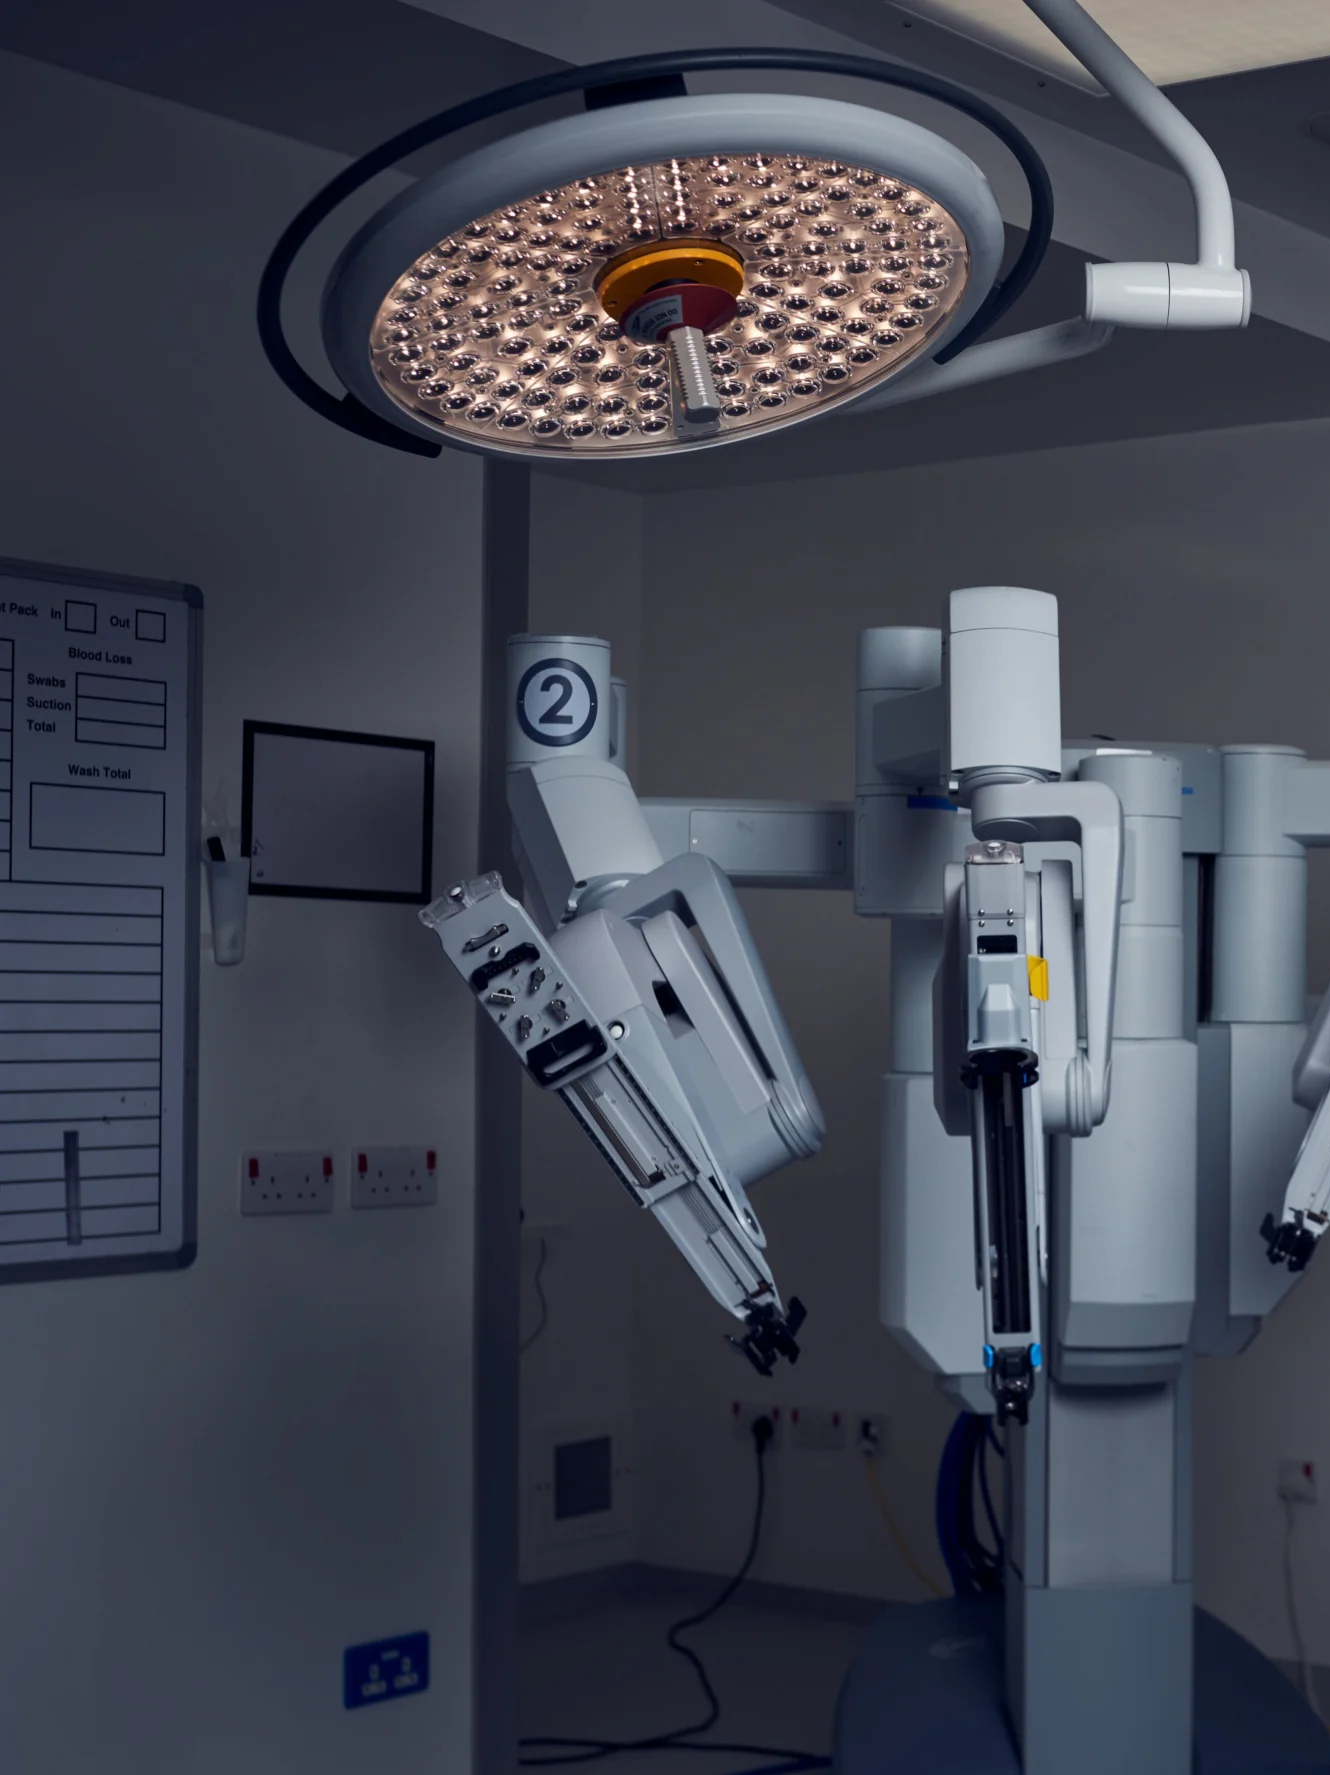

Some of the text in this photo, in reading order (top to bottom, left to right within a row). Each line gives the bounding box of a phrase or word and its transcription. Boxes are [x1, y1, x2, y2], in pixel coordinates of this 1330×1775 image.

[9, 602, 39, 617] Pack
[50, 607, 62, 620] In
[109, 615, 130, 629] Out
[68, 646, 133, 665] Blood Loss
[27, 673, 66, 688] Swabs
[26, 696, 72, 711] Suction
[538, 674, 573, 724] 2
[26, 719, 56, 733] Total
[68, 763, 132, 780] Wash Total
